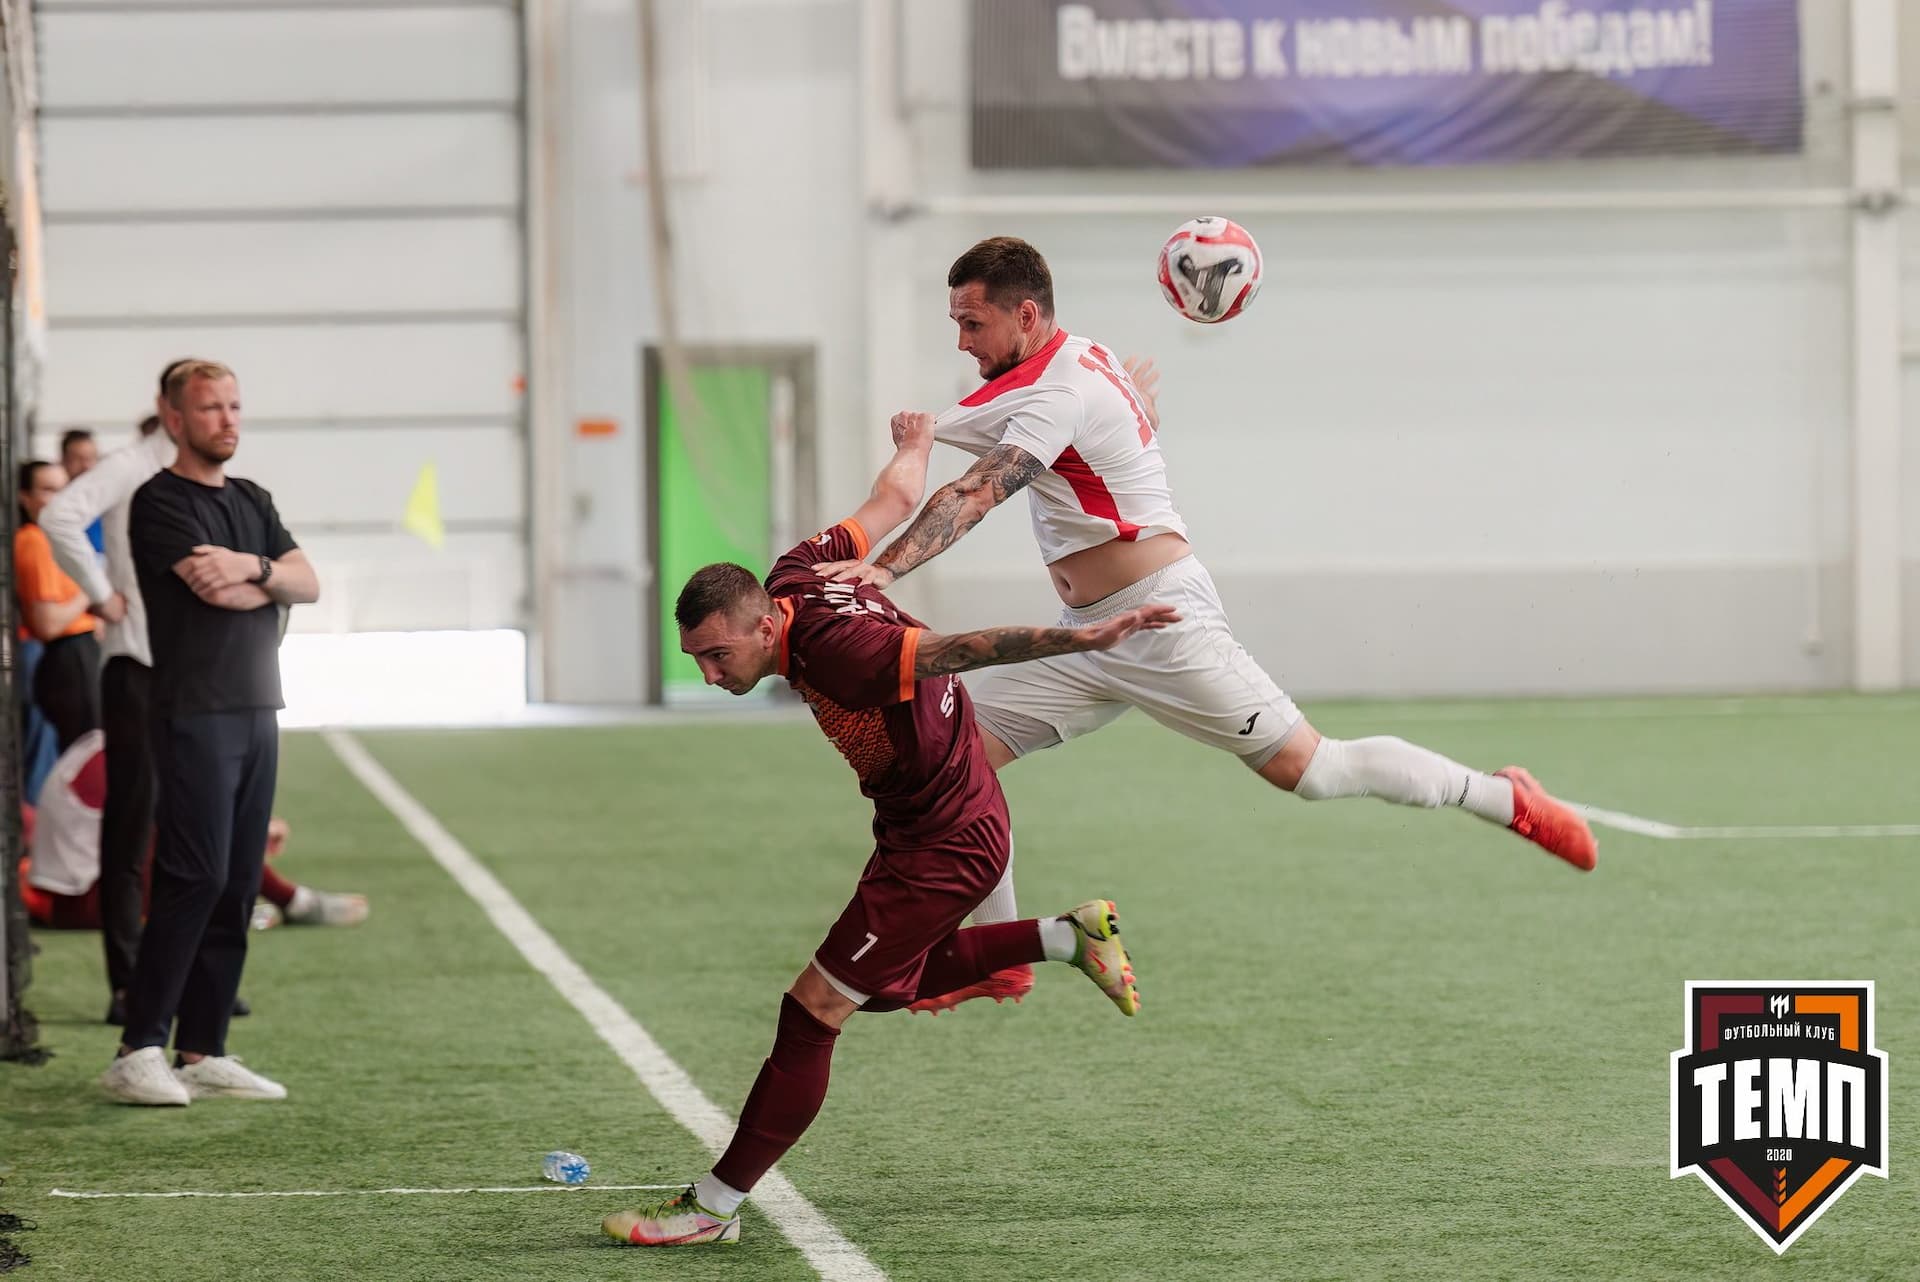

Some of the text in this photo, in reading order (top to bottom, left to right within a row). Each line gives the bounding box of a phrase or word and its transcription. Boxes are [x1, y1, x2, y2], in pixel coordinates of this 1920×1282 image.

[1056, 0, 1713, 80] Вместе к новым победам!
